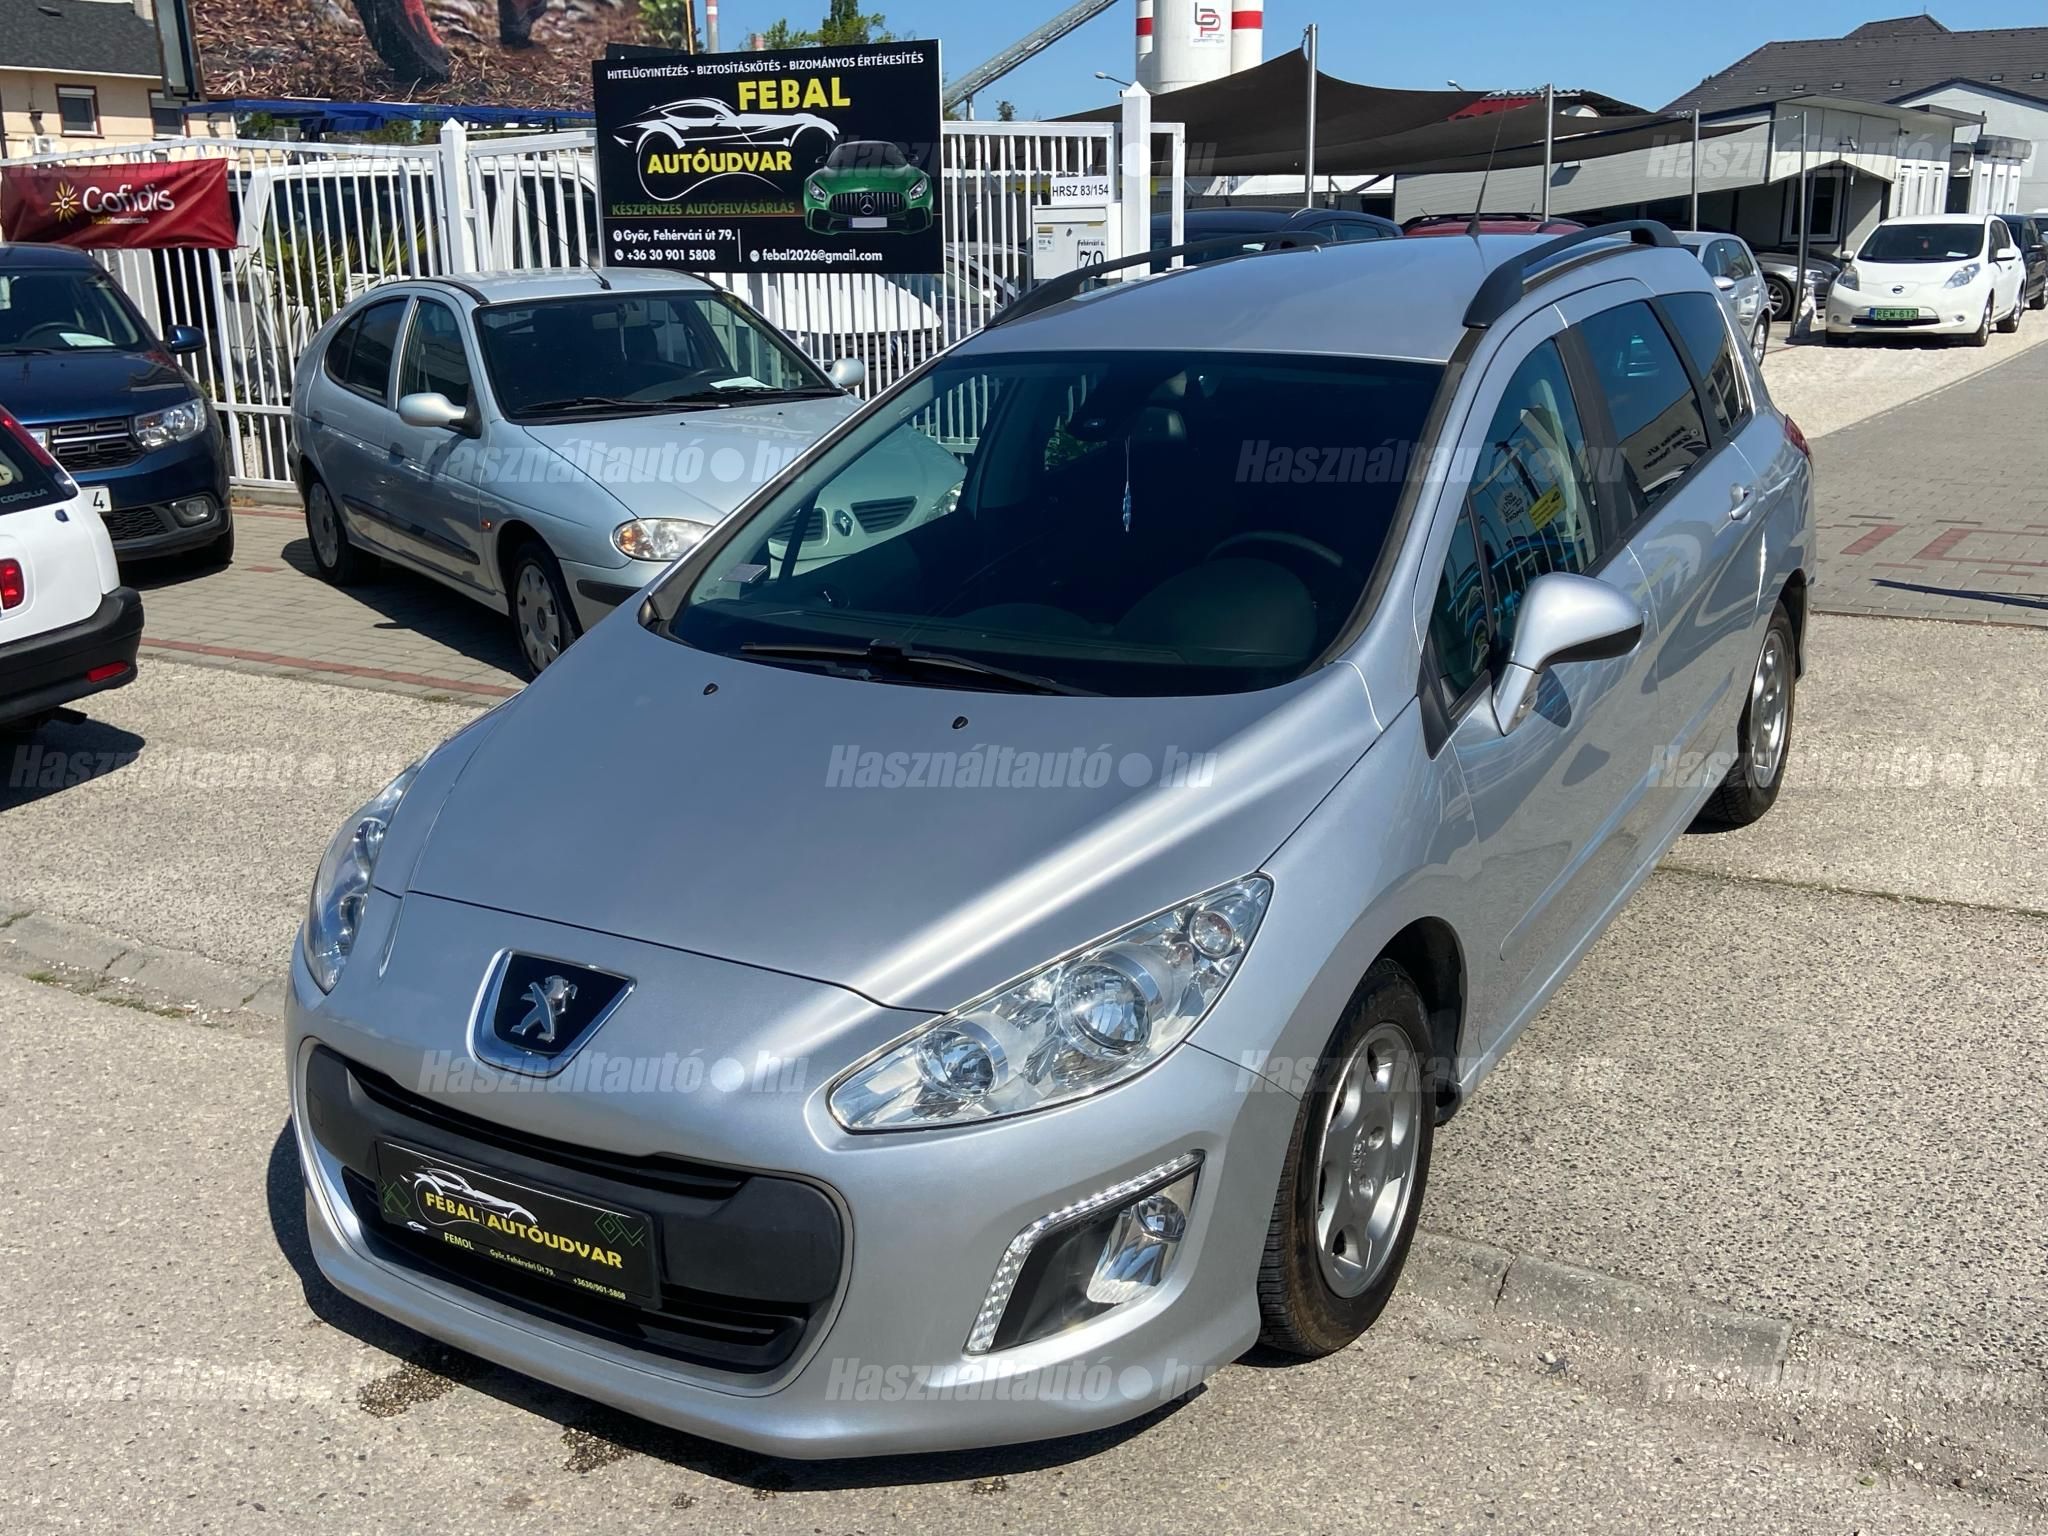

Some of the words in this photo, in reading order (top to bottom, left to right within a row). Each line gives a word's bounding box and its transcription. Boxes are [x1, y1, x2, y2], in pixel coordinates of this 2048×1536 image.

[697, 60, 781, 75] BIZTOSÍTÁSKÖTÉS
[789, 56, 856, 71] BIZOMÁNYOS
[857, 50, 924, 67] ÉRTÉKESÍTÉS
[737, 76, 851, 111] FEBAL
[647, 147, 792, 174] AUTÓUDVAR
[83, 182, 175, 214] Cofidis
[1052, 185, 1078, 197] HRSZ
[1080, 184, 1109, 196] 83/154
[612, 203, 682, 216] KÉSZPÉNZES
[686, 201, 796, 215] AUTÓFELVÁSÁRLÁS
[623, 229, 651, 244] Győr,
[653, 229, 703, 241] Fehérvári
[705, 228, 716, 241] út
[718, 229, 736, 241] 79.
[627, 249, 647, 261] +36
[649, 249, 663, 261] 30
[665, 249, 685, 261] 901
[688, 249, 717, 261] 5808
[762, 248, 883, 264] febal2026@gmail.com
[1876, 310, 1917, 319] REW-612
[1, 488, 48, 504] COROLLA
[425, 1191, 480, 1222] FEBAL
[487, 1215, 623, 1269] AUTÓUDVAR
[444, 1231, 475, 1251] FEMOL
